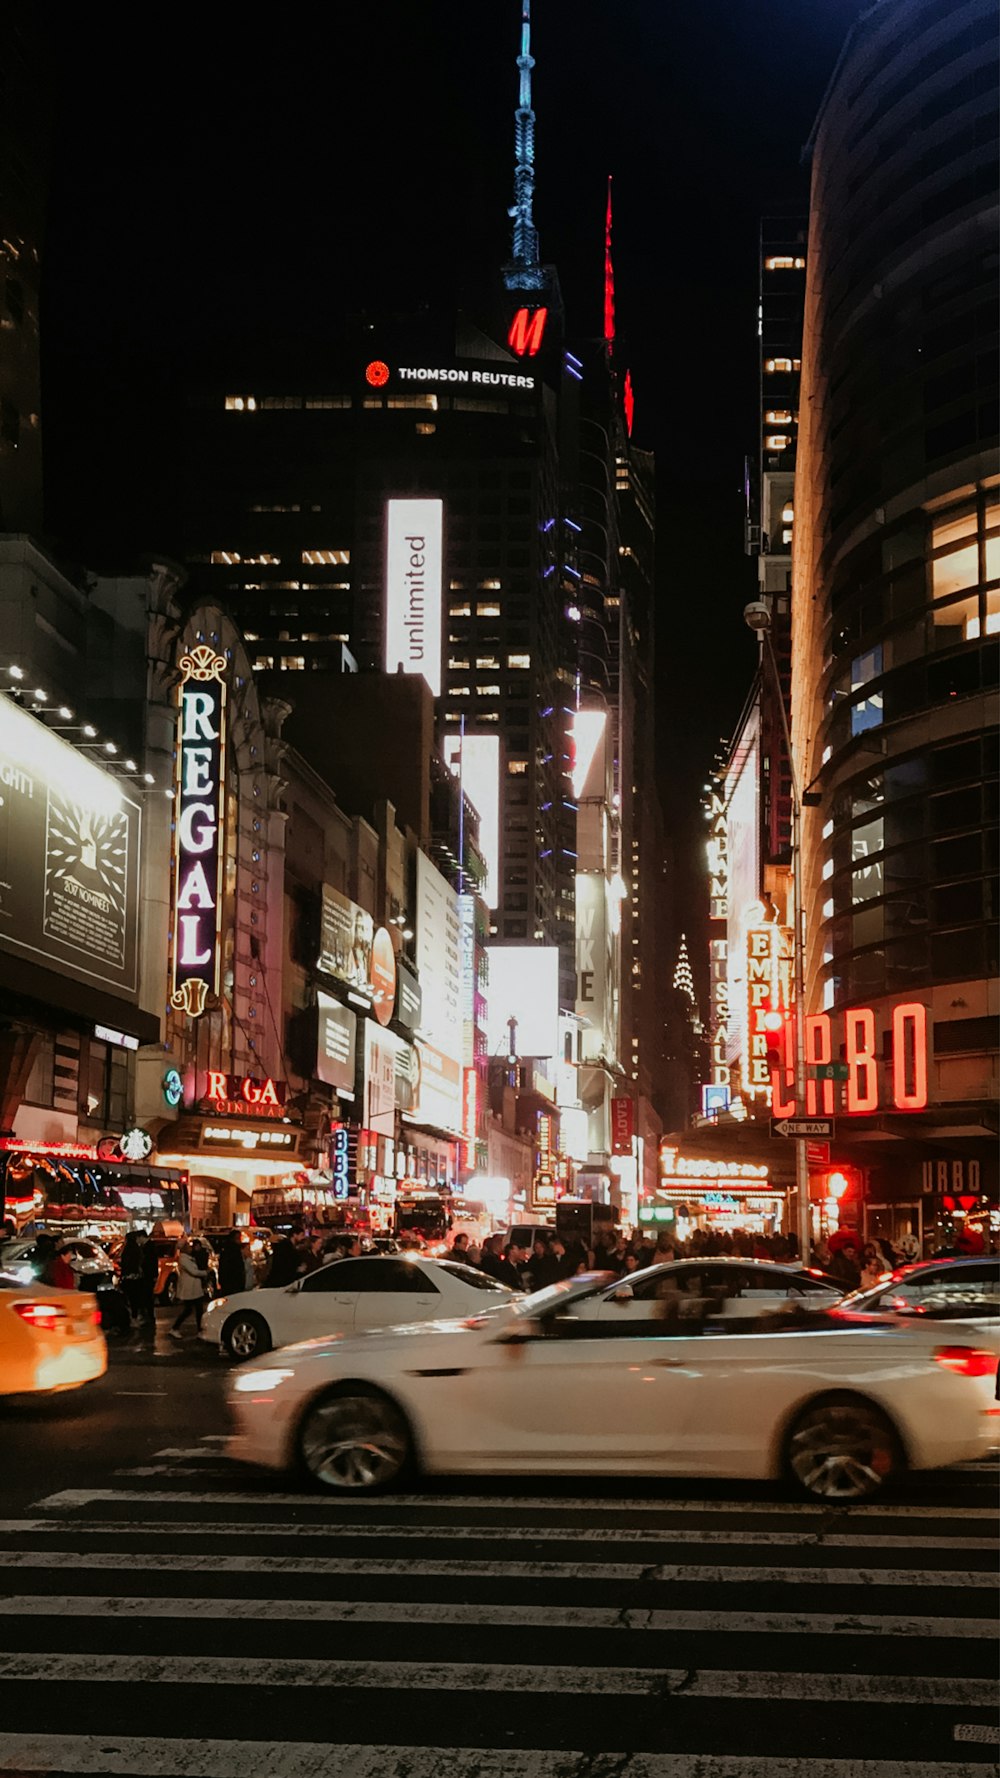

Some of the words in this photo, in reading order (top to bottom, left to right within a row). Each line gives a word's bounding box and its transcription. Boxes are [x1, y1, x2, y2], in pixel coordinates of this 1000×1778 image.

[399, 367, 468, 383] THOMSON
[472, 371, 534, 389] REUTERS
[404, 535, 426, 661] unlimited
[178, 692, 218, 965] REGAL
[749, 933, 772, 1083] EMPIRE
[826, 1066, 834, 1078] 8
[216, 1101, 286, 1118] CINEMAS
[616, 1101, 628, 1137] LOVE
[781, 1124, 801, 1132] ONE
[806, 1124, 826, 1132] WAY
[334, 1129, 349, 1199] BBQ
[923, 1161, 980, 1192] URBO
